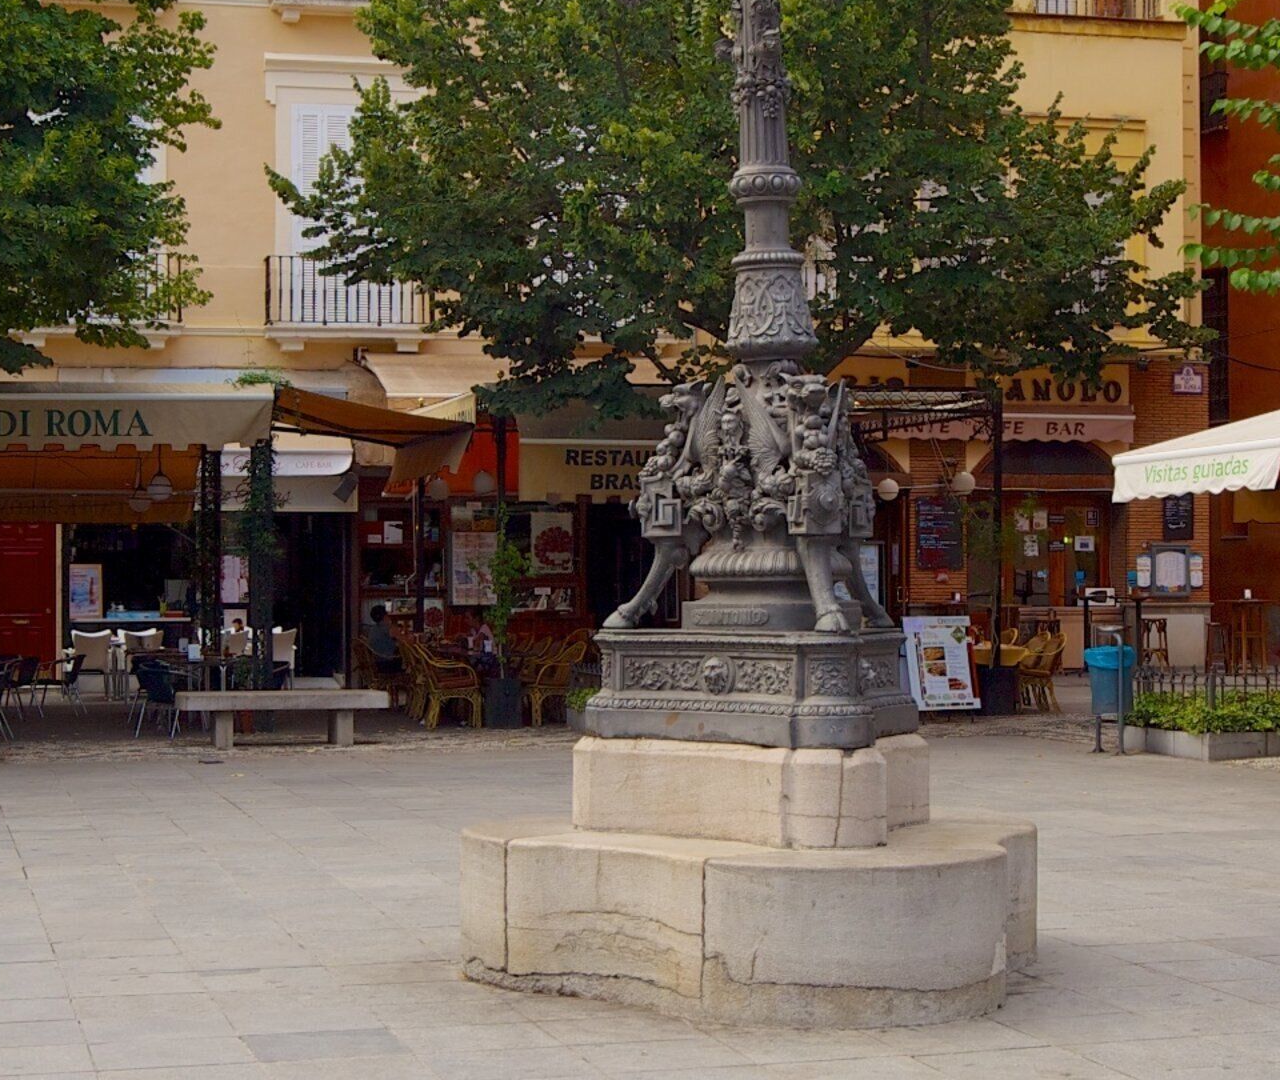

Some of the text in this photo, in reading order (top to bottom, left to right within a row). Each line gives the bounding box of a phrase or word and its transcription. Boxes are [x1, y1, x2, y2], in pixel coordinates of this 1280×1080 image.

[1005, 378, 1122, 403] ANOLO
[44, 409, 154, 437] ROMA
[1046, 422, 1086, 436] BAR
[565, 449, 657, 467] RESTAU
[1144, 456, 1249, 483] Visitas guiadas
